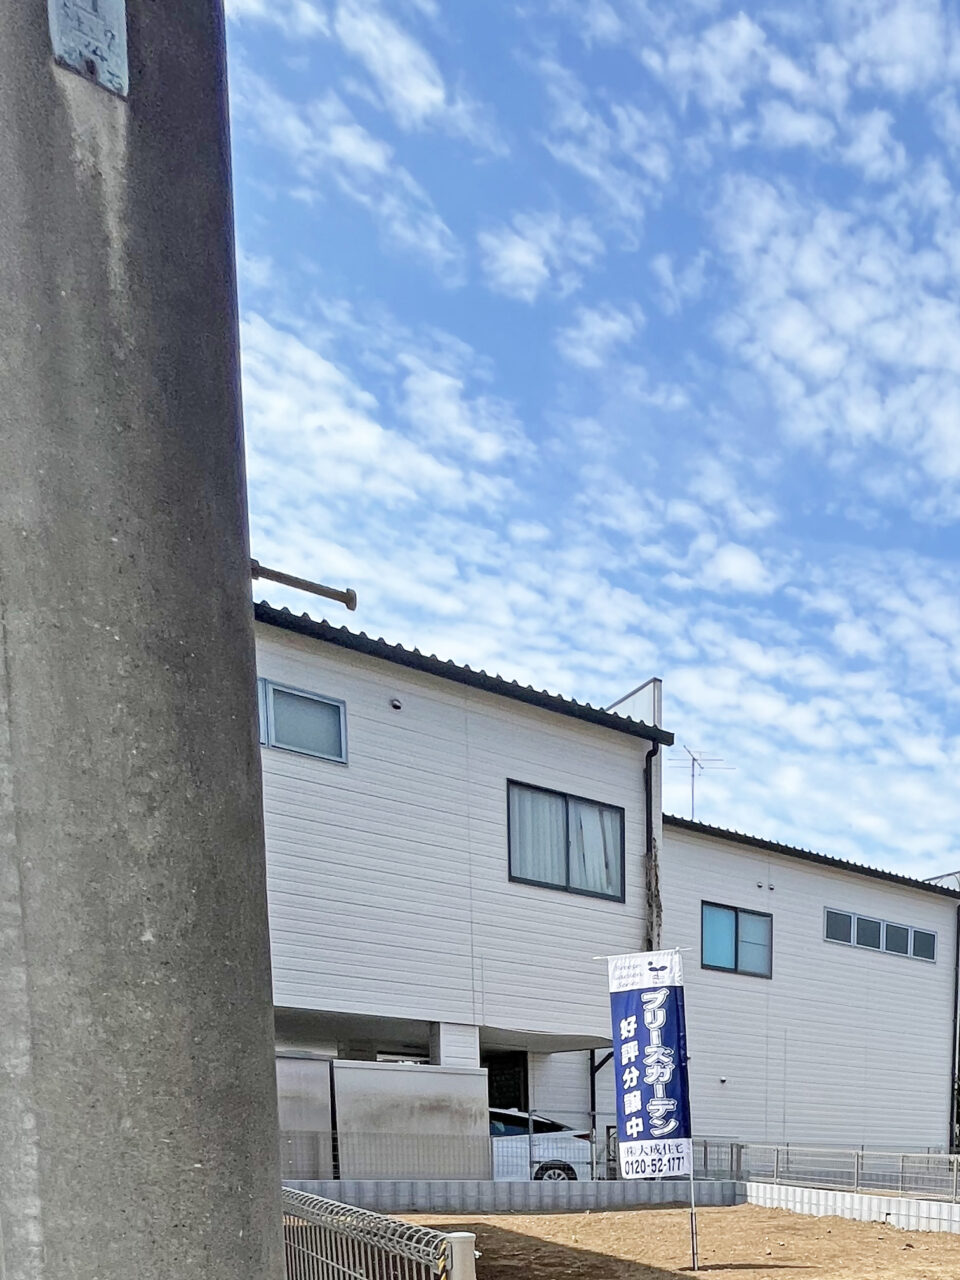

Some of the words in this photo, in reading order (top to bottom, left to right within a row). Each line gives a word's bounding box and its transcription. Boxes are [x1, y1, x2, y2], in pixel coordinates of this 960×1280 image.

[641, 987, 679, 1137] ブリーズガーデン
